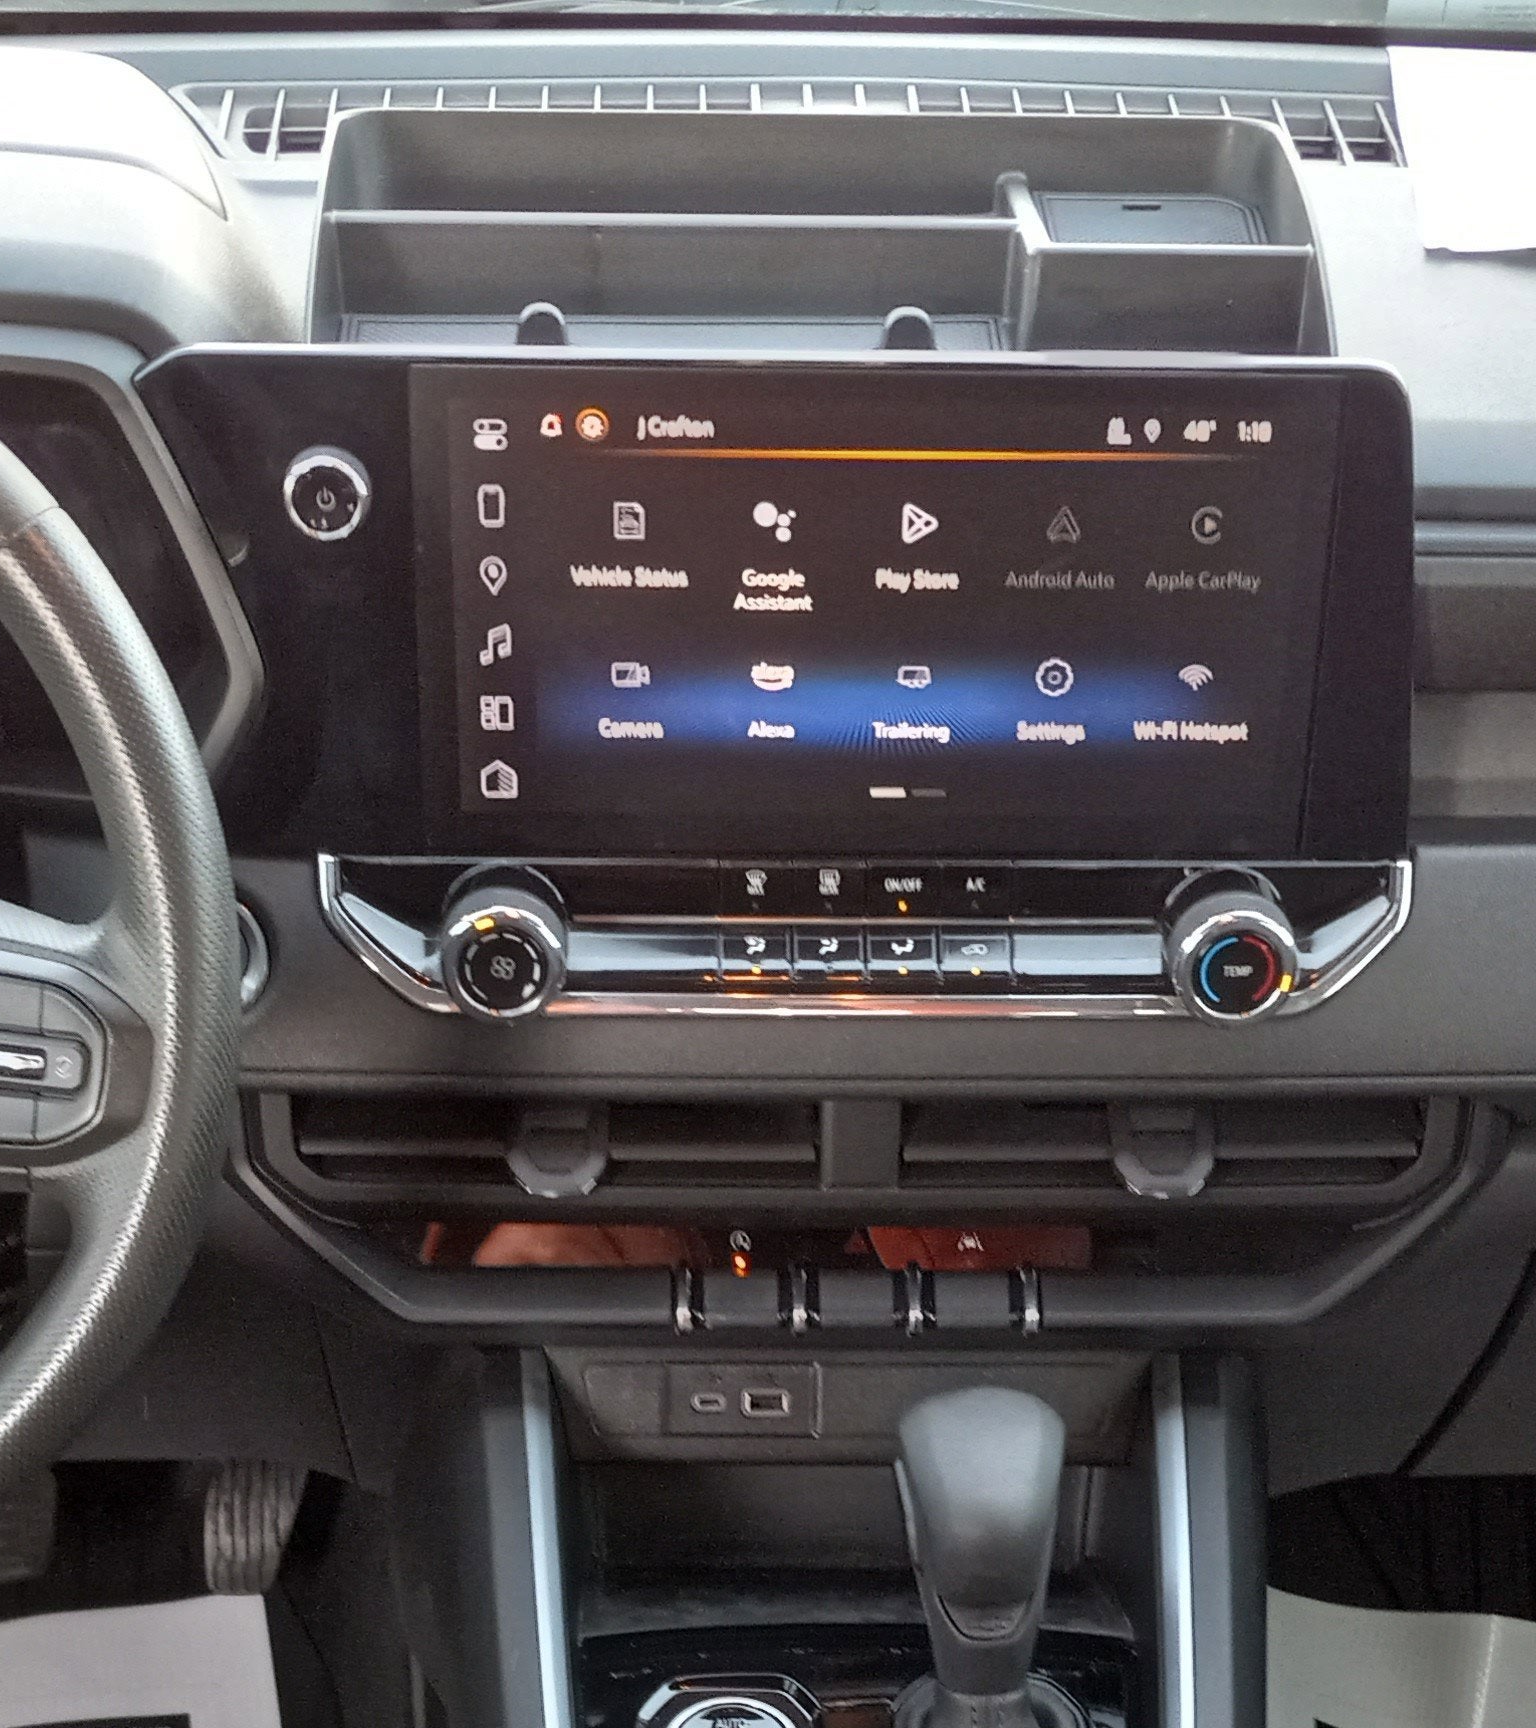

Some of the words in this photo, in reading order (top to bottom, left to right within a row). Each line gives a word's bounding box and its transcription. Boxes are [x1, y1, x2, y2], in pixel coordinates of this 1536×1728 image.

[569, 564, 632, 587] Vehicle
[634, 566, 689, 588] Status
[741, 568, 806, 592] Google
[875, 567, 912, 594] Play
[913, 568, 960, 590] Store
[1005, 570, 1073, 589] Android
[1074, 570, 1115, 589] Auto
[1144, 570, 1195, 593] Apple
[1198, 569, 1262, 594] CarPlay
[733, 592, 814, 612] Assistant
[598, 717, 664, 739] Camera
[747, 720, 795, 739] Alexa
[872, 721, 951, 743] Trailering
[1016, 720, 1086, 745] Settings
[1133, 720, 1178, 741] Wi-Fi
[1180, 720, 1249, 744] Hotspot
[884, 877, 923, 893] ON/OFF
[1222, 965, 1254, 978] TEMP
